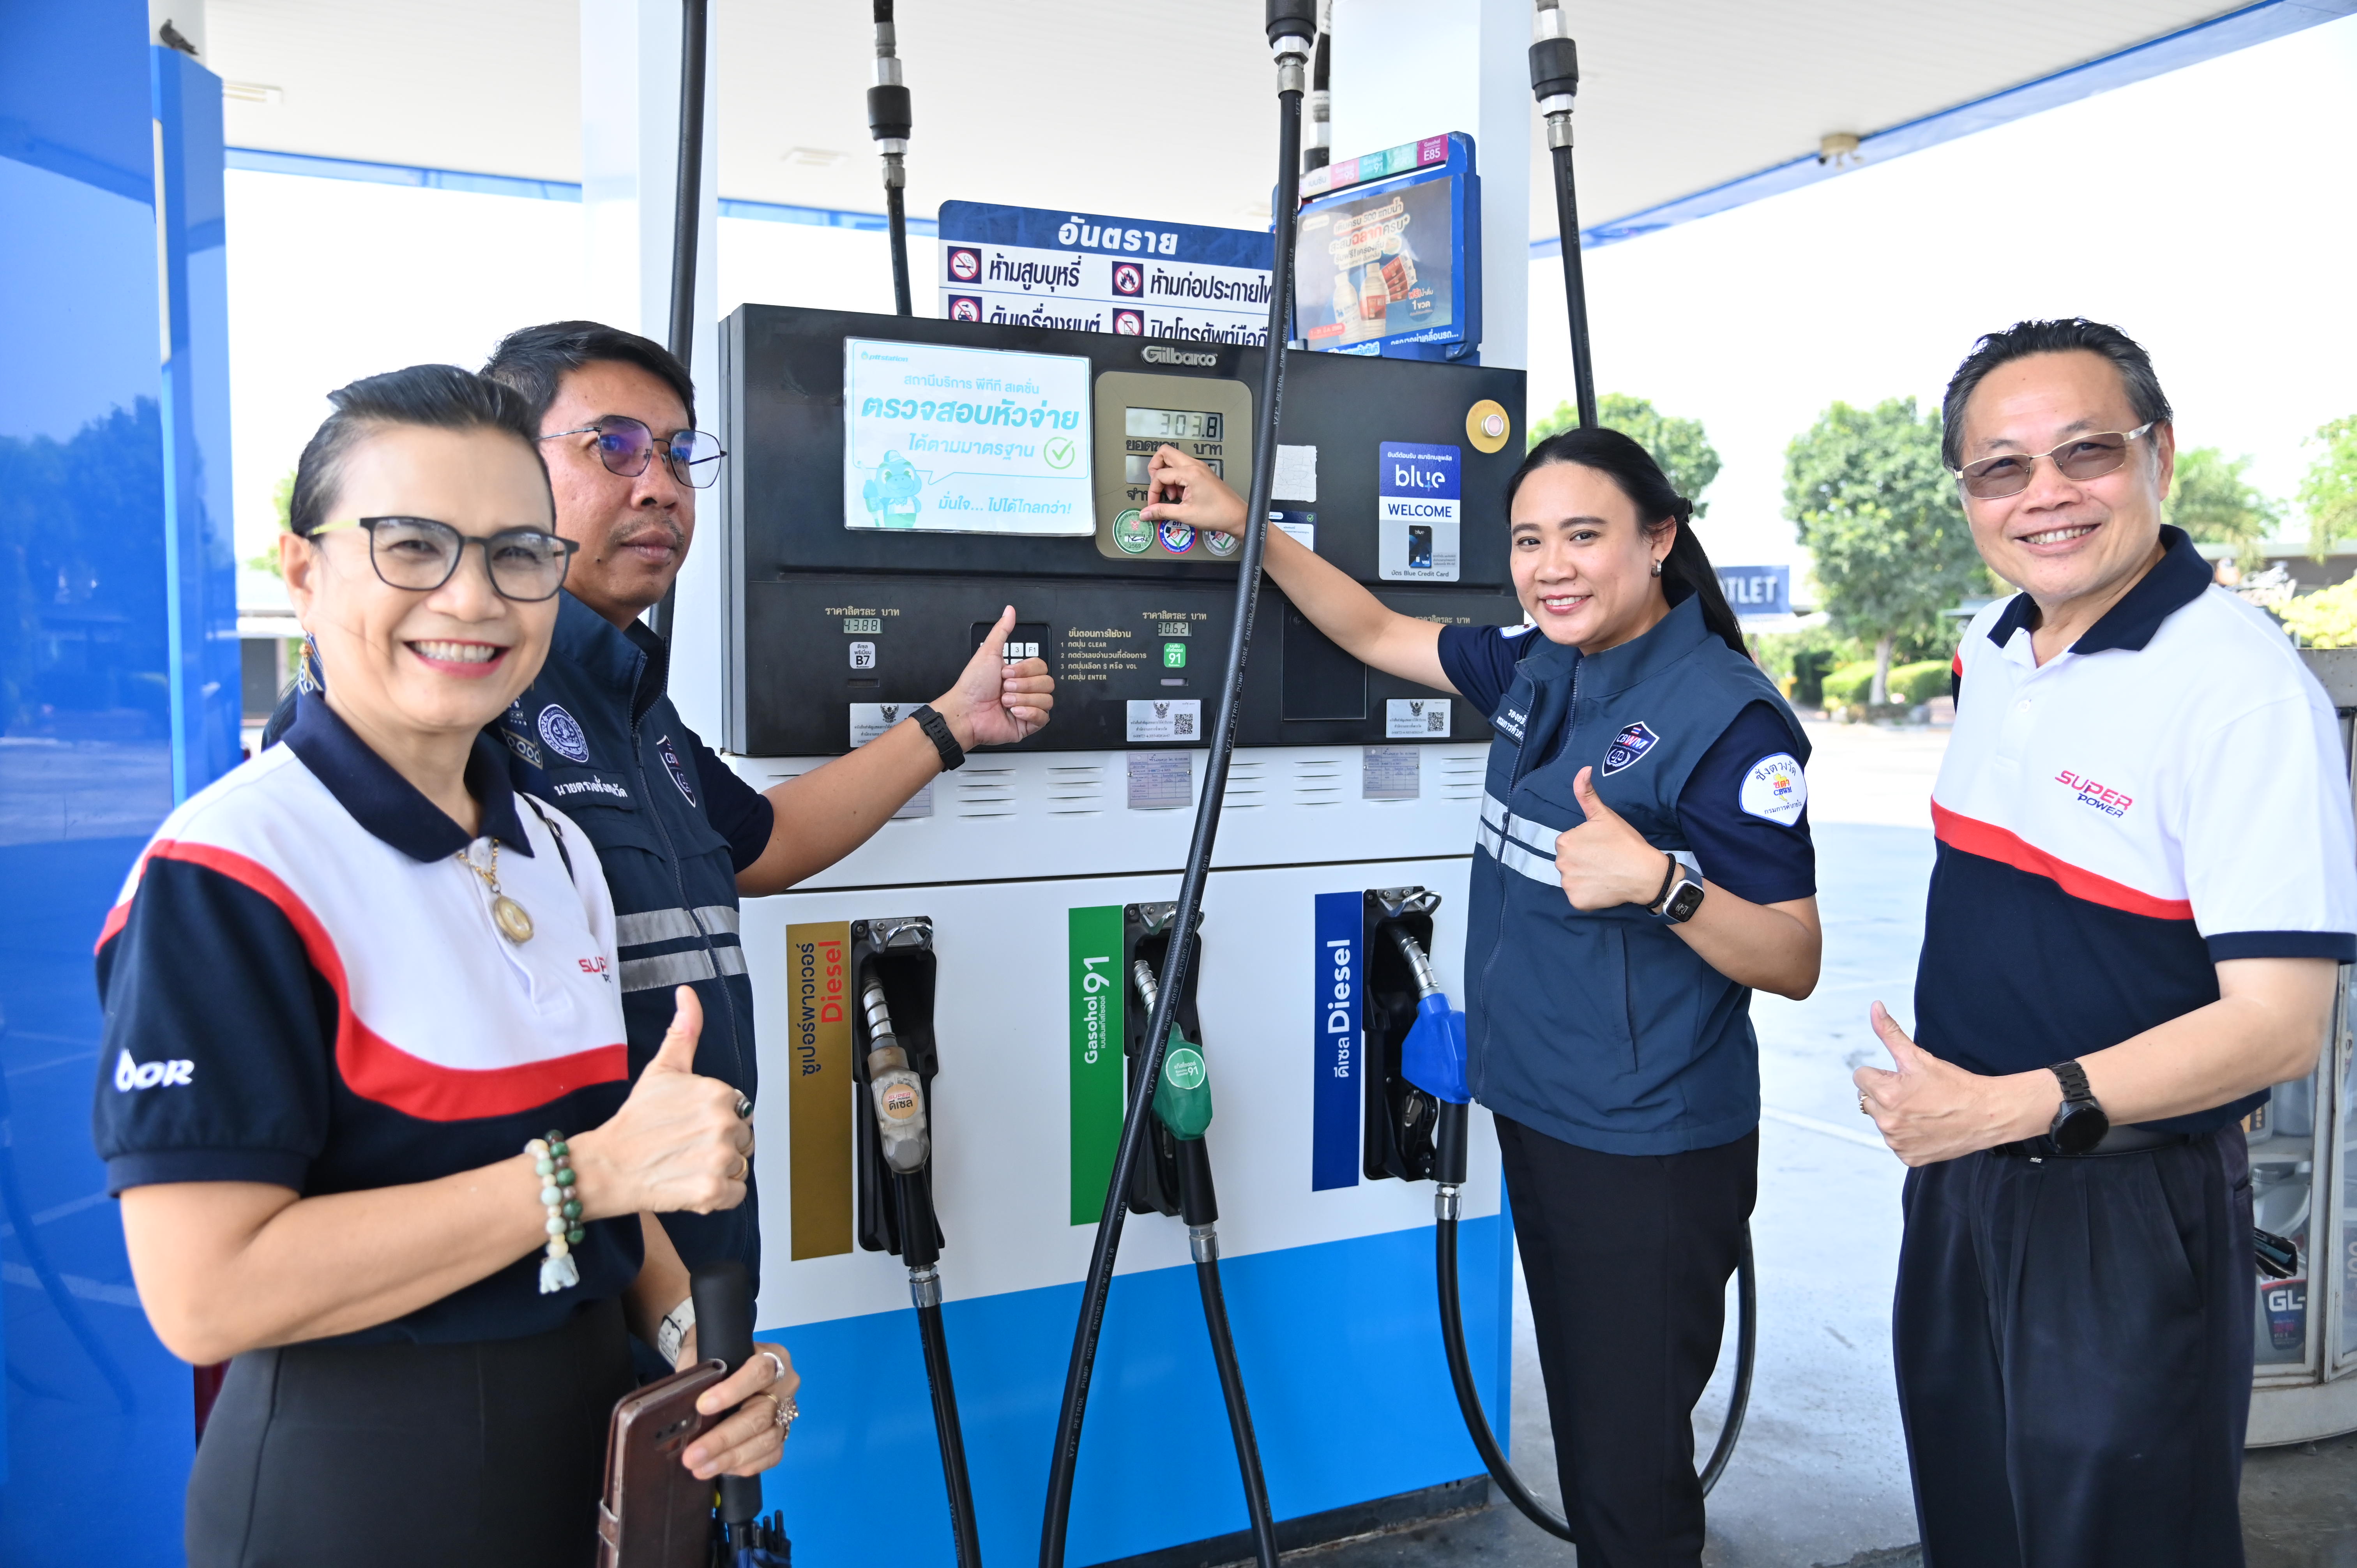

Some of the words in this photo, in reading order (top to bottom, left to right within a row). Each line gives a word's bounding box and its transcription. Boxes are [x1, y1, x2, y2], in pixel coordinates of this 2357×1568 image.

[1424, 147, 1441, 161] E85
[1374, 162, 1383, 173] 91
[1058, 215, 1178, 256] อันตราย
[989, 252, 1083, 293] ห้ามสูบบุหรี่
[1143, 346, 1218, 367] Gilbarco
[904, 374, 972, 389] สถานีบริการ
[975, 378, 1001, 392] พีทีที
[1005, 378, 1039, 394] สเตชั่น
[1276, 374, 1284, 402] PETROL
[861, 396, 1079, 430] ตรวจสอบหัวจ่าย
[1160, 413, 1218, 438] 303.8
[908, 433, 1035, 460] ได้ตามมาตรฐาน
[1193, 443, 1222, 456] บาท
[1417, 453, 1452, 462] สมาชิกบลูพลัส
[988, 497, 1072, 514] ไปได้ไกลกว่า!
[1388, 503, 1452, 518] WELCOME
[1726, 576, 1778, 604] TLET
[825, 606, 876, 616] ราคาลิตรละ
[881, 608, 900, 616] บาท
[1142, 610, 1186, 620] ราคาลิตรละ
[1191, 612, 1207, 620] บาท
[844, 620, 878, 631] 43.88
[1068, 627, 1131, 638] ขั้นตอนการใช้งาน
[1068, 639, 1086, 649] กดปุ่ม
[856, 655, 870, 665] B7
[1068, 649, 1147, 659] กดตัวเลขจำนวนที่ต้องการ
[1168, 653, 1180, 664] 91
[1068, 661, 1101, 671] กดปุ่มเลือก
[1068, 671, 1086, 682] กดปุ่ม
[1230, 699, 1240, 729] PETROL
[1236, 671, 1244, 692] PUMP
[1616, 733, 1648, 749] CBWM
[1755, 760, 1796, 781] ชั่งตวงวัด
[1774, 786, 1792, 796] CBWM
[2055, 770, 2133, 811] SUPER
[1764, 799, 1802, 814] กรมการค้าภายใน
[2077, 793, 2124, 818] POWER
[578, 956, 607, 973] SUP
[818, 940, 843, 1023] Diesel
[1083, 956, 1110, 994] 91
[1327, 938, 1351, 1034] Diesel
[797, 942, 821, 1077] ซูเปอร์พาวเวอร์
[1085, 996, 1099, 1065] Gasohol
[1154, 1037, 1167, 1069] PETROL
[1163, 1009, 1173, 1031] PUMP
[1171, 983, 1180, 1004] HOSE
[1334, 1036, 1350, 1078] ดีเซล
[1187, 1066, 1199, 1076] 91
[889, 1099, 913, 1111] ดีเซล
[1073, 1395, 1085, 1429] PETROL
[1080, 1365, 1089, 1388] PUMP
[1087, 1336, 1096, 1359] HOSE
